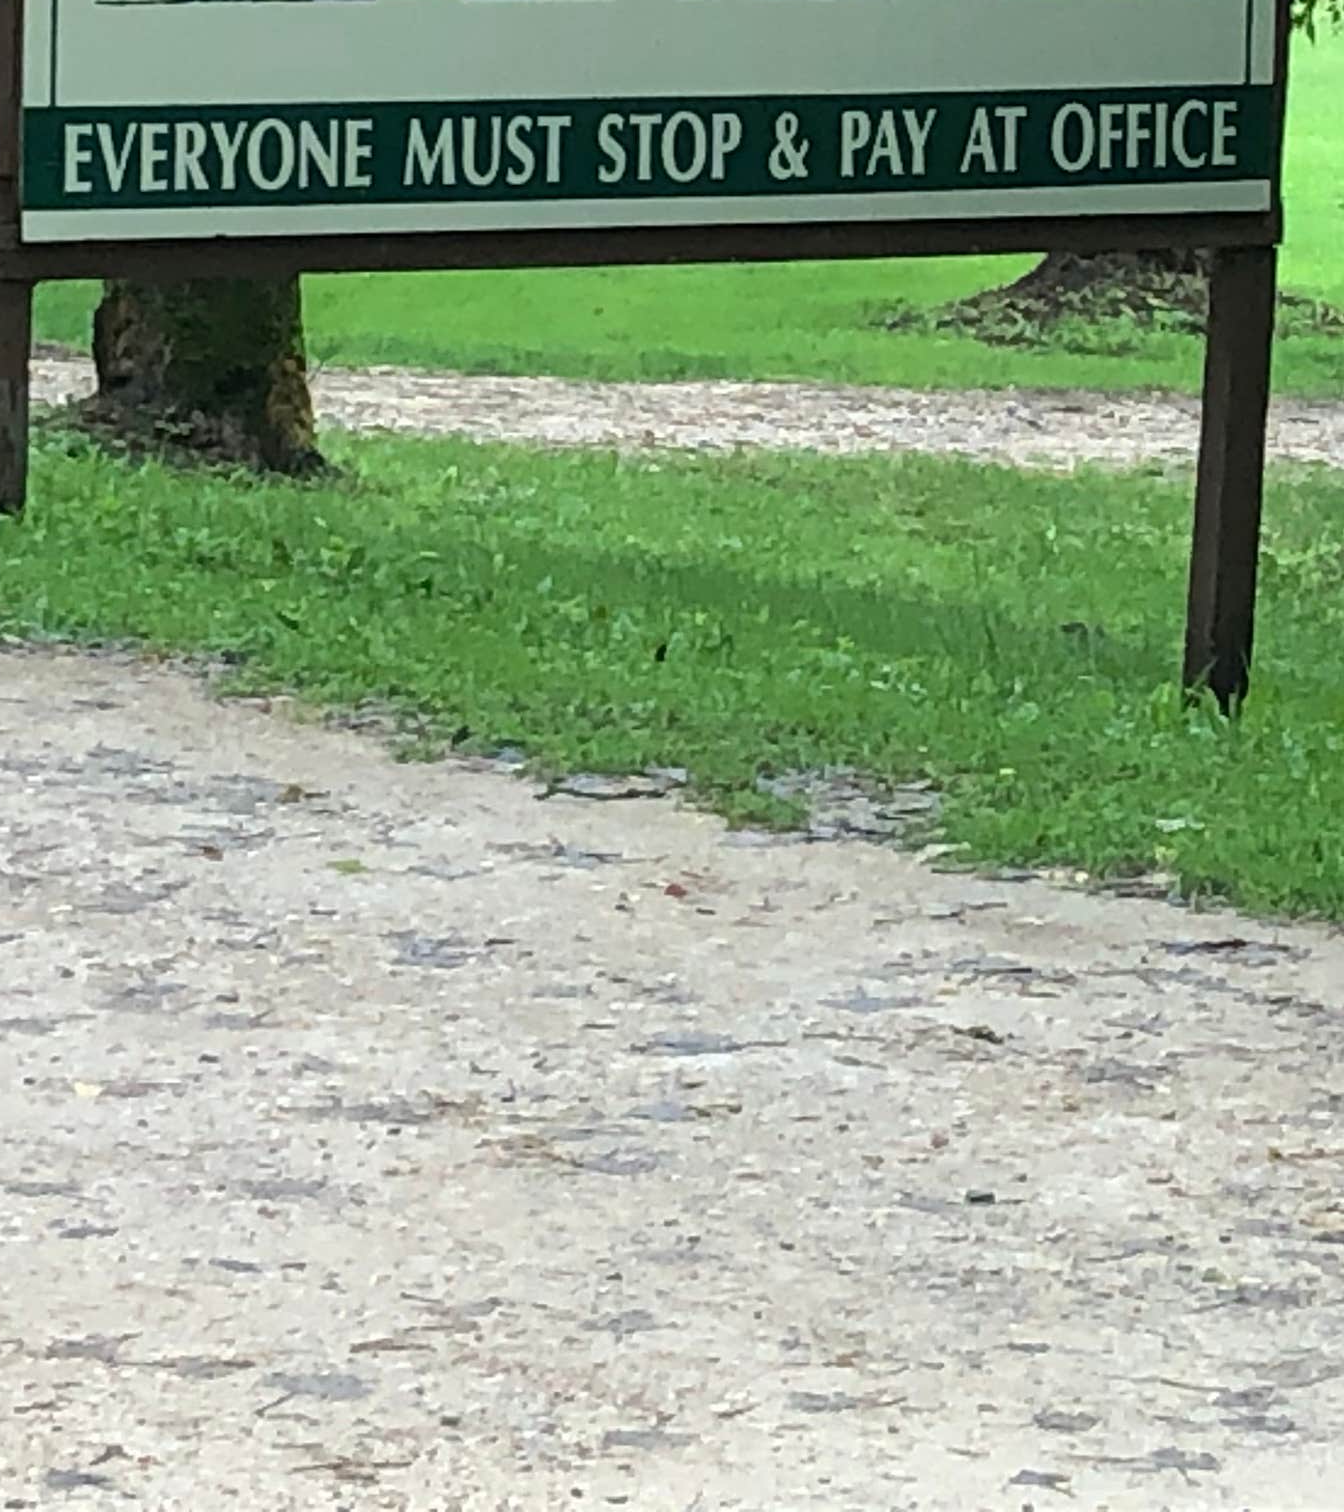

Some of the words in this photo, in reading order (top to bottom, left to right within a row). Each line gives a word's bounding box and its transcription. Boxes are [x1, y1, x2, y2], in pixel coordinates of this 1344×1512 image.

[64, 118, 373, 192] EVERYONE
[403, 115, 572, 186] MUST
[598, 111, 742, 183] STOP
[768, 111, 809, 180] &
[840, 108, 937, 177] PAY
[960, 106, 1028, 173] AT
[1051, 99, 1238, 172] OFFICE
